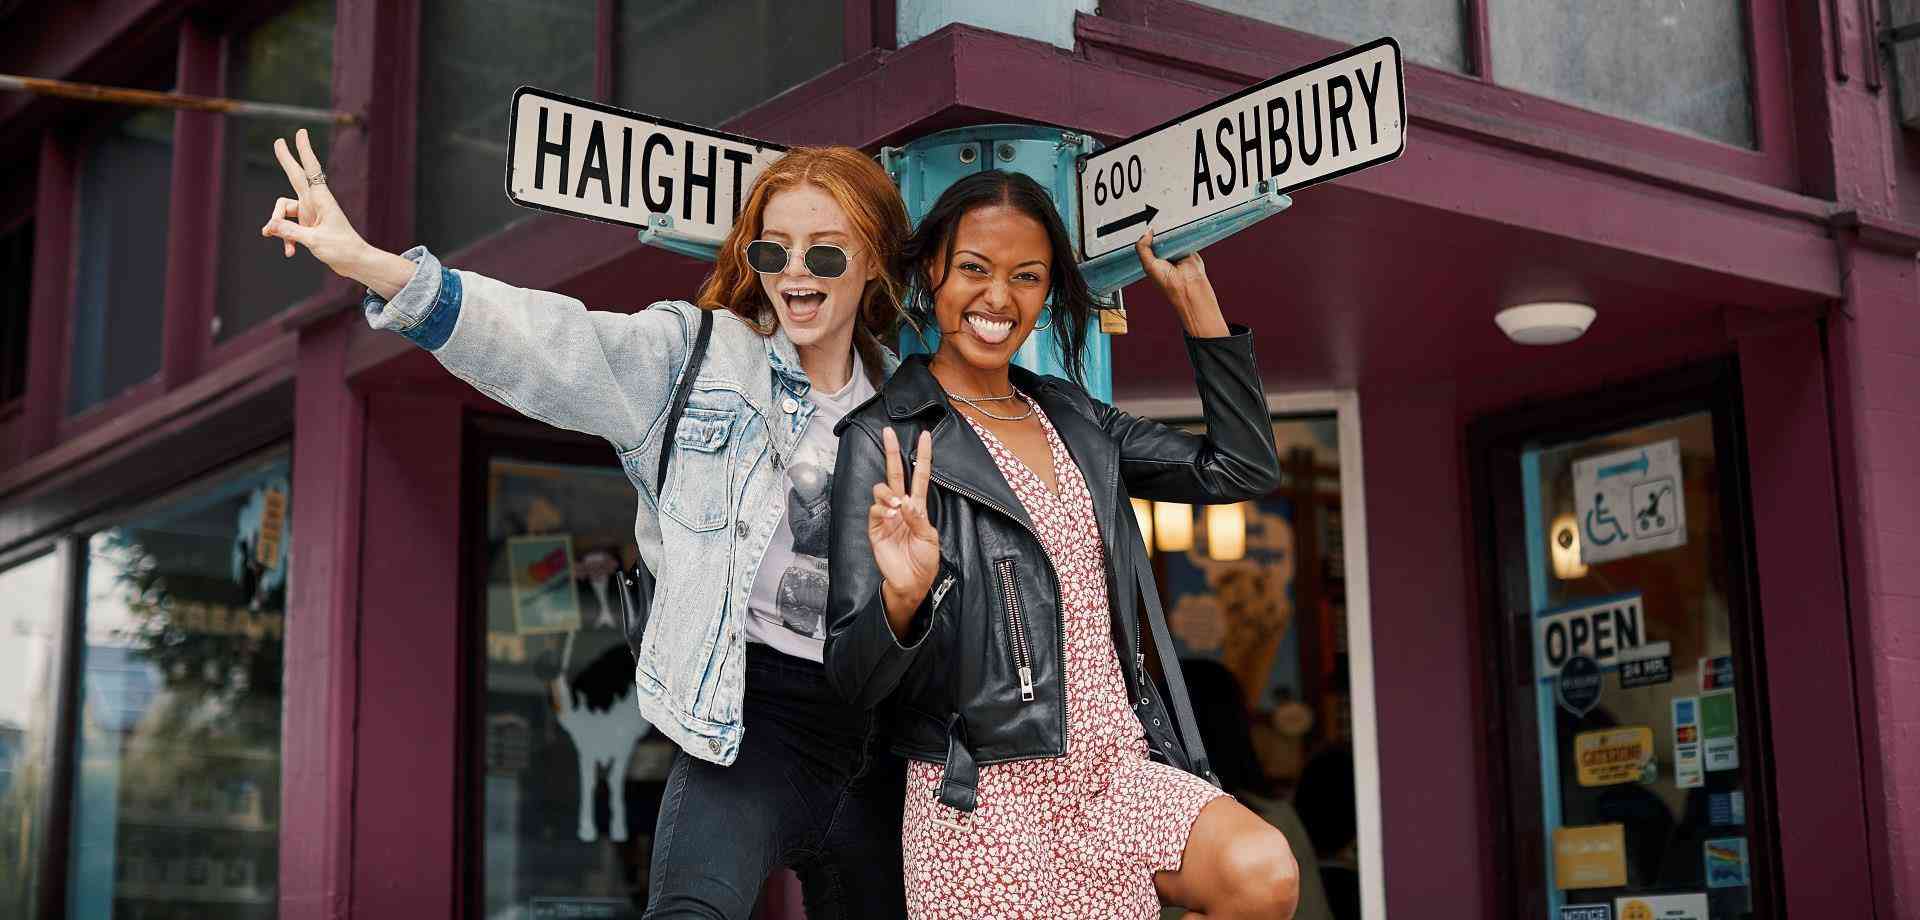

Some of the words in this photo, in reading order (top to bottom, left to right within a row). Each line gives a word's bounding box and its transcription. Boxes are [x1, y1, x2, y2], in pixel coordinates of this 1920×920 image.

[534, 106, 753, 225] HAIGHT
[1192, 61, 1382, 206] ASHBURY
[1094, 154, 1142, 206] 600
[1545, 606, 1639, 666] OPEN
